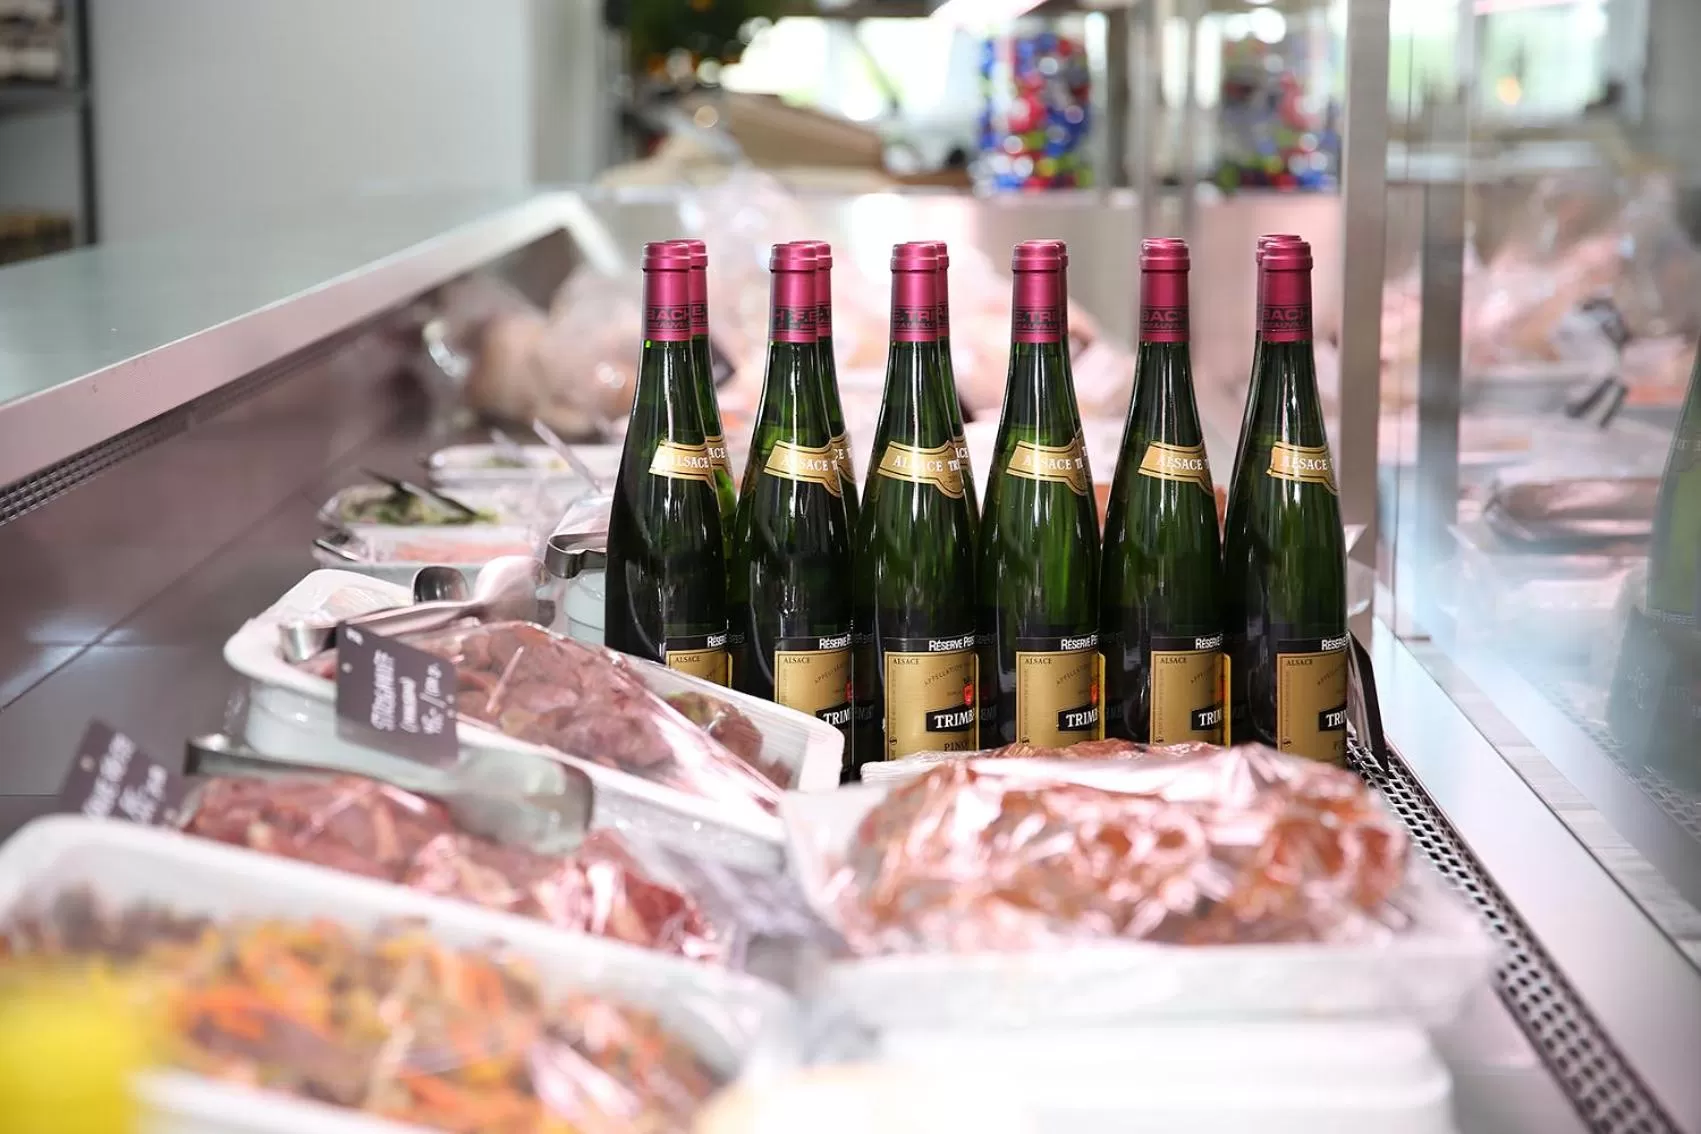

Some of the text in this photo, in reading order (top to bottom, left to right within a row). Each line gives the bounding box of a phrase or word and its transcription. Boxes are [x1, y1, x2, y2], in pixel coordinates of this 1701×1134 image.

[666, 456, 709, 469] LSACE
[780, 457, 829, 472] ASACE
[892, 455, 943, 472] ALCE
[1022, 455, 1072, 471] ASACE
[928, 638, 962, 652] RÉSERVE
[674, 655, 701, 664] ALSACE
[782, 656, 811, 664] ALSACE
[1160, 657, 1188, 665] ALSACE
[1286, 658, 1313, 666] ALSACE
